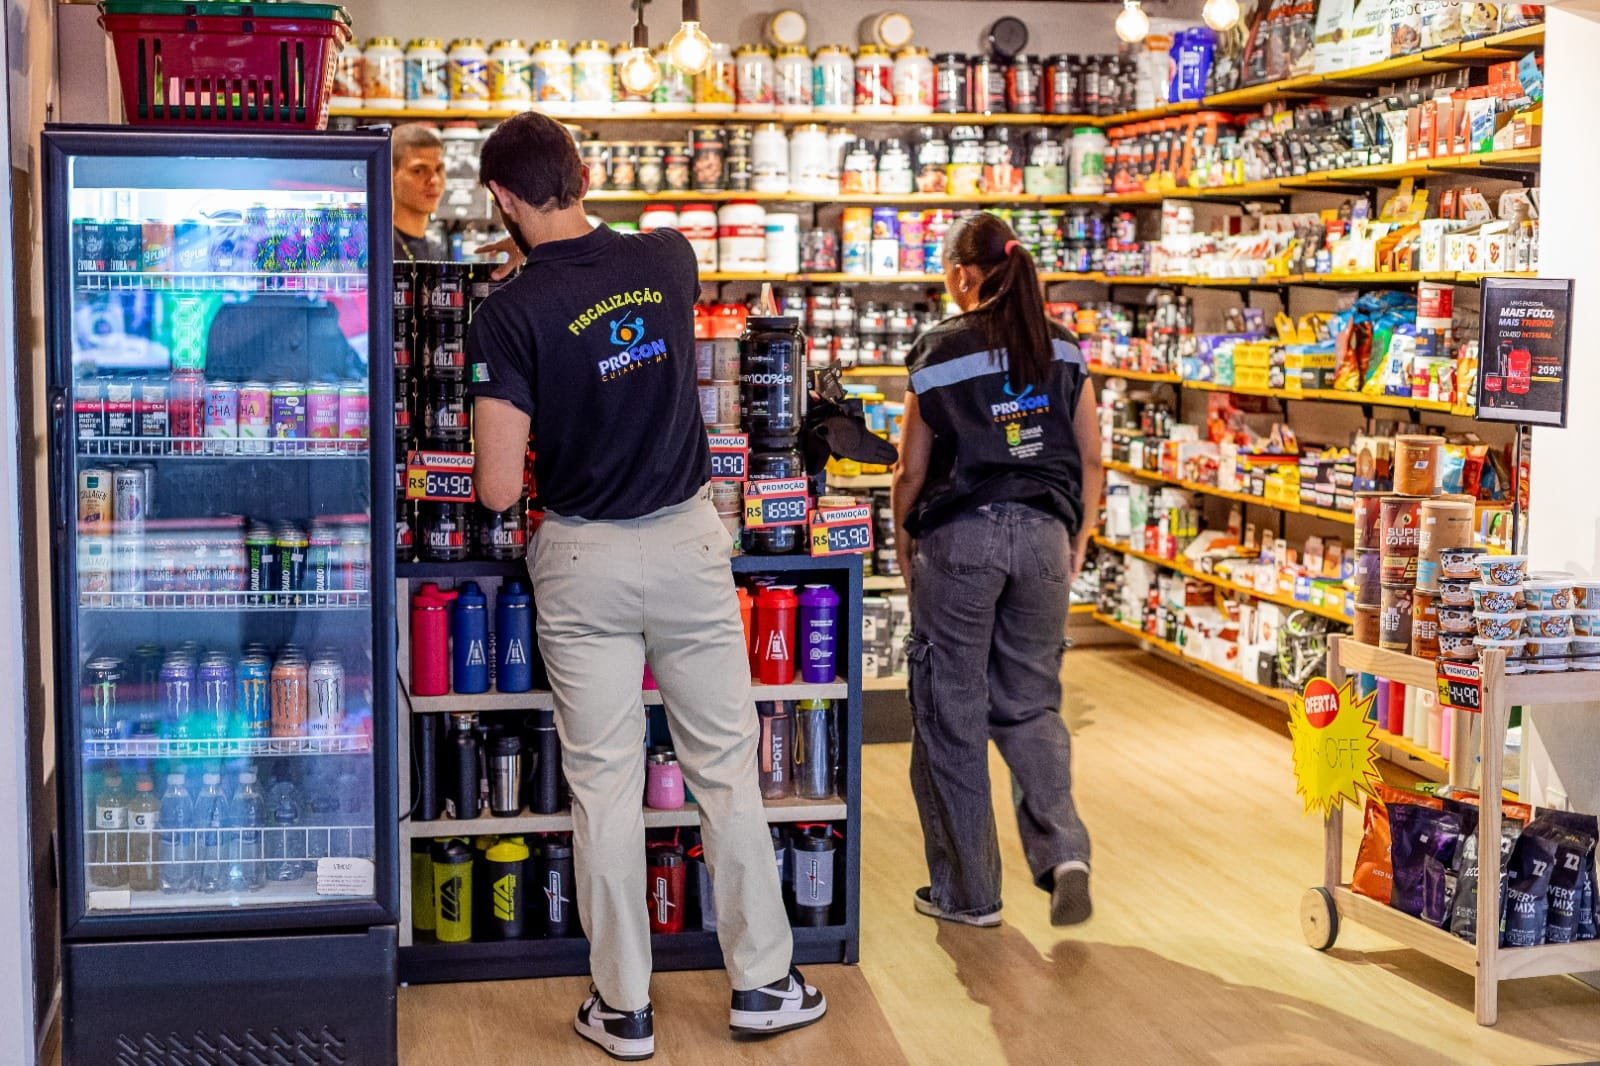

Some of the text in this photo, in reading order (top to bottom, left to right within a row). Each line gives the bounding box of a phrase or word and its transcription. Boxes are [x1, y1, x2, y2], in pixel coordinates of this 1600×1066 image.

[568, 287, 663, 336] FISCALIZAÇÃO
[1500, 307, 1555, 319] MAIS FOCO,
[1499, 318, 1520, 327] MAIS
[598, 338, 667, 375] PROCON
[241, 403, 256, 416] HA
[991, 394, 1050, 416] PROCON
[709, 437, 745, 447] OMOÇÃO
[426, 456, 473, 466] PROMOÇÃO
[711, 456, 745, 474] 9.90
[408, 474, 472, 494] R$ 64.90
[762, 482, 805, 492] PROMOÇÃO
[746, 506, 762, 518] R$
[826, 509, 868, 521] PROMOÇÃO
[813, 527, 870, 547] R$ 45.90
[1387, 528, 1420, 537] SUPE
[1386, 536, 1420, 545] COFFE
[1305, 694, 1338, 714] OFERTA
[772, 734, 783, 782] SPORT
[1325, 737, 1360, 772] OFF
[1514, 902, 1536, 913] MIX
[1553, 899, 1575, 911] MIX
